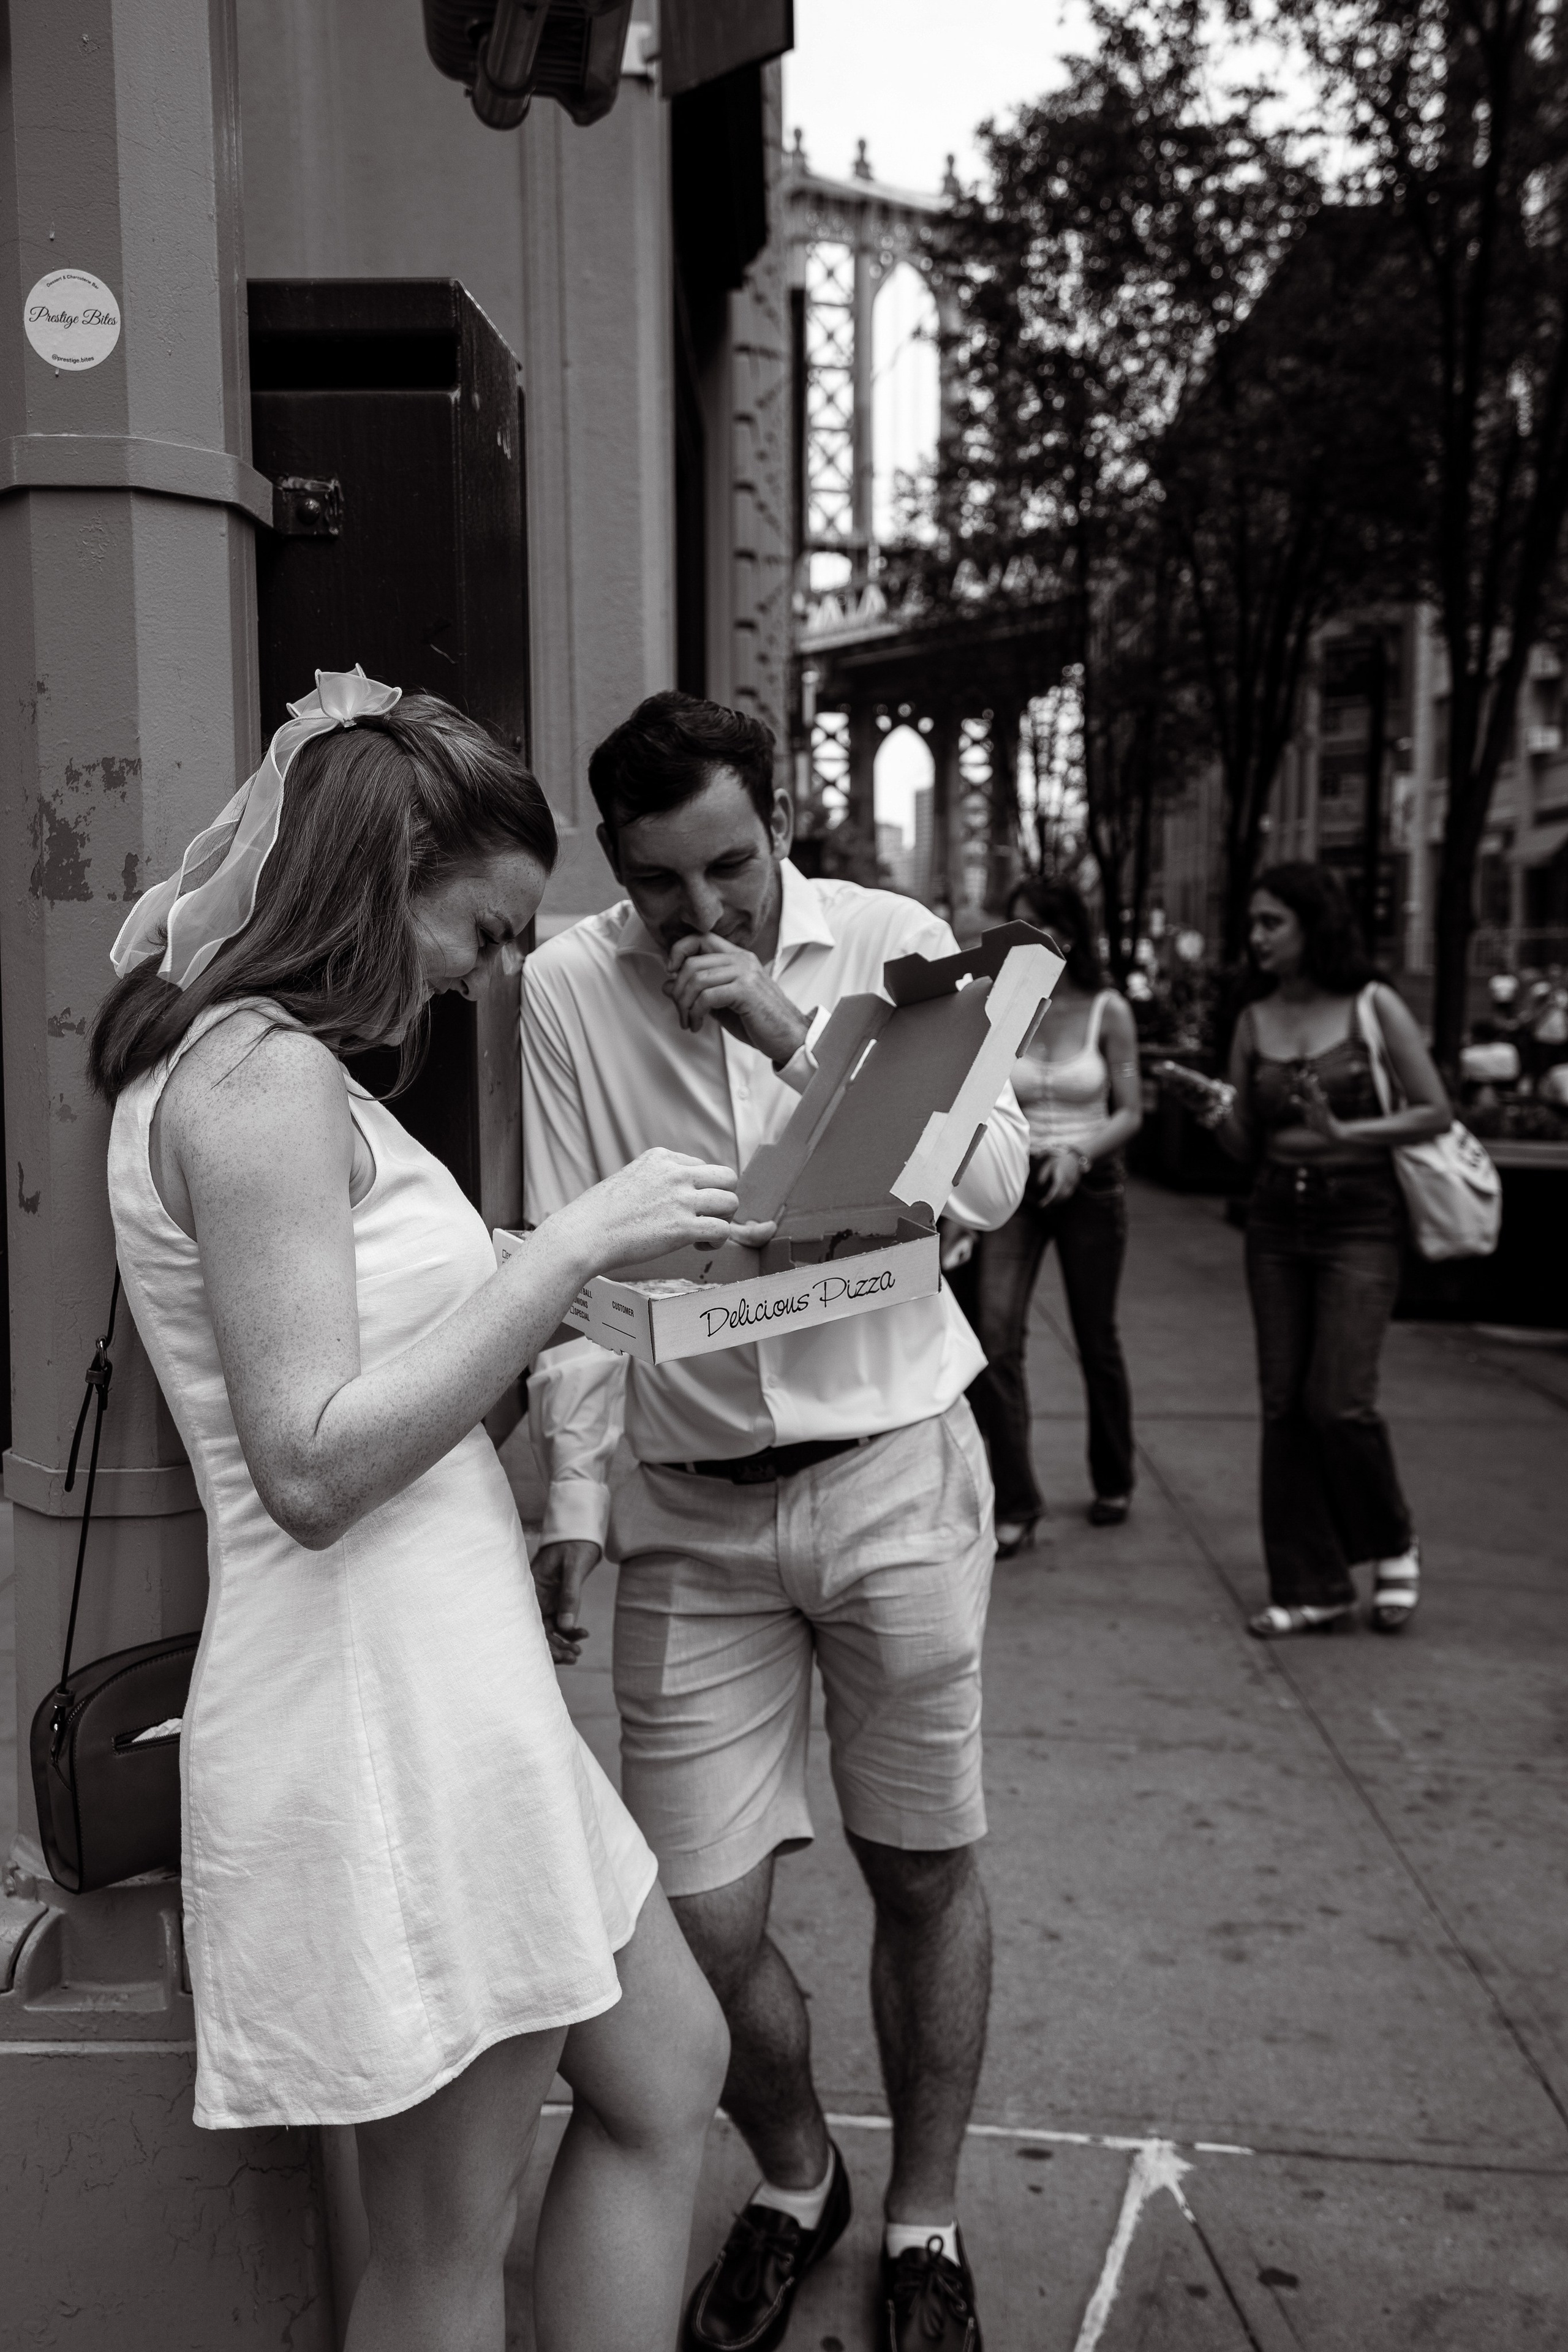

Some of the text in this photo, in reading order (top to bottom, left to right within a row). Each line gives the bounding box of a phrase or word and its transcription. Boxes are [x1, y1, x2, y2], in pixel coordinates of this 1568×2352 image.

[46, 277, 62, 287] Dessert
[67, 274, 91, 284] Charcuterie
[29, 306, 118, 329] Prestige Bites
[51, 353, 94, 364] @prestige.bites
[612, 1300, 635, 1317] CUSTOMER
[699, 1271, 895, 1337] Delicious Pizza
[574, 1308, 590, 1322] SPECIAL
